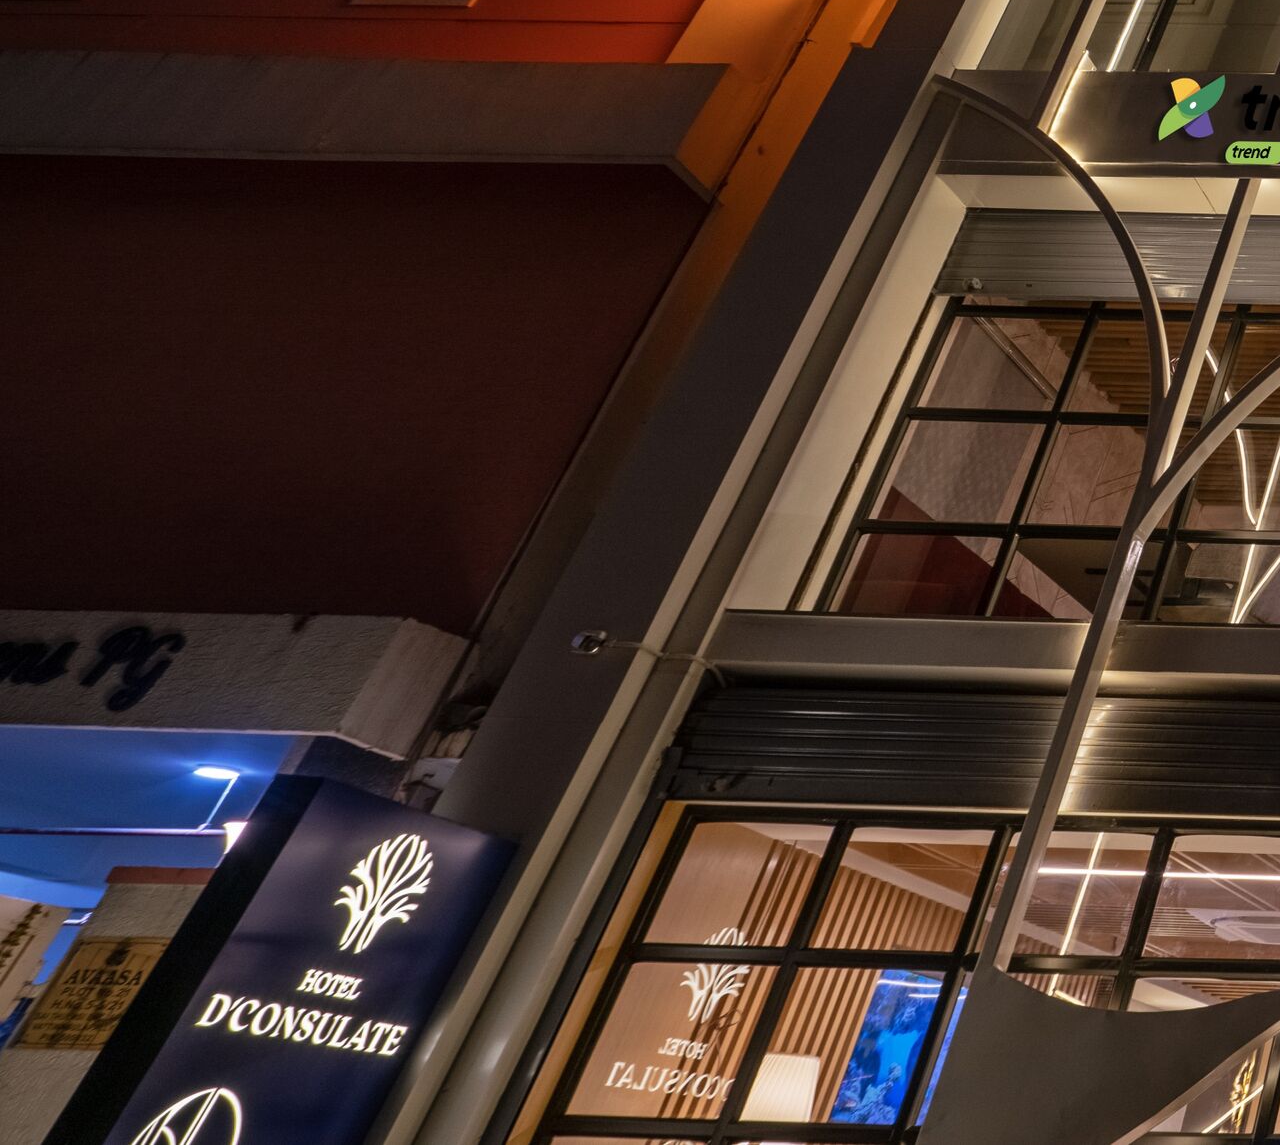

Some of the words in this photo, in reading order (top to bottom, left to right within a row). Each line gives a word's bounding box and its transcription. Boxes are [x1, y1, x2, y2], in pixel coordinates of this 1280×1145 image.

[1231, 144, 1271, 160] trend
[296, 968, 364, 1001] HOTEL
[194, 992, 409, 1057] D'CONSULATE
